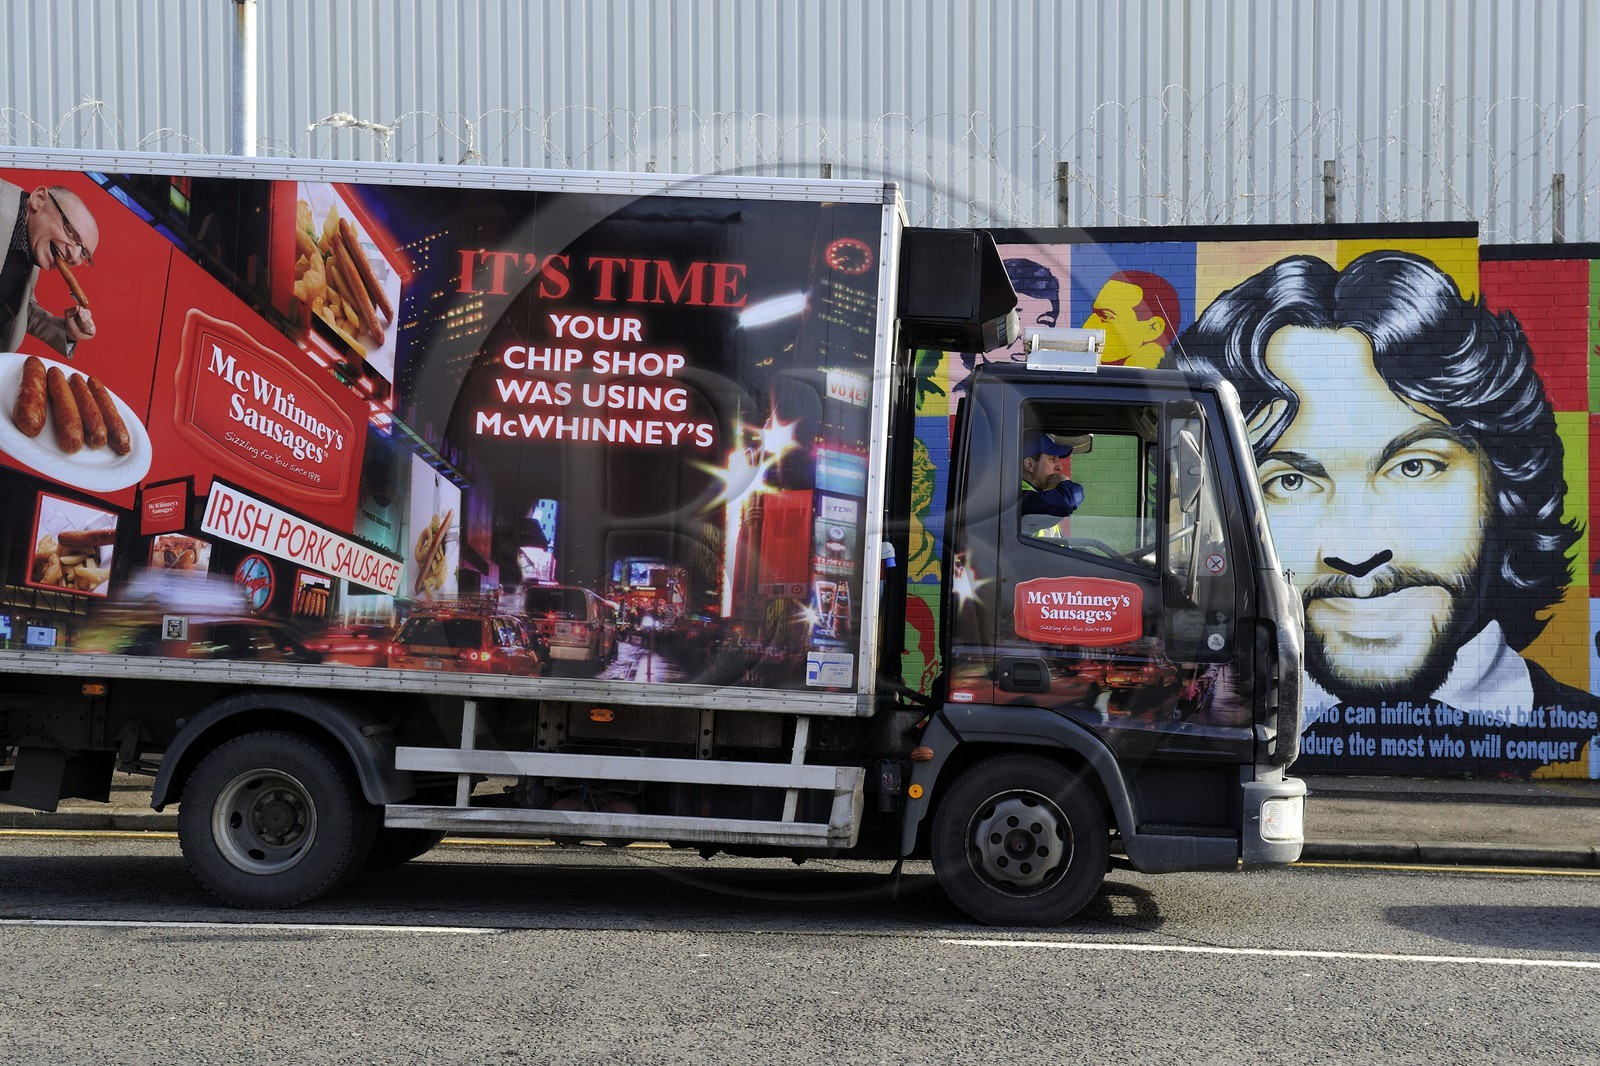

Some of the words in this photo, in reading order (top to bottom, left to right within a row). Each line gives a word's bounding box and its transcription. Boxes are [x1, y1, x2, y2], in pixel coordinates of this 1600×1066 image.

[455, 249, 570, 299] IT'S
[588, 256, 748, 309] TIME
[549, 313, 643, 342] YOUR
[503, 345, 583, 373] CHIP
[592, 349, 685, 378] SHOP
[207, 343, 344, 451] McWhinney's
[495, 378, 572, 406] WAS
[582, 383, 688, 412] USING
[475, 411, 714, 448] McWHINNEY'S
[224, 431, 259, 458] Sizzling
[260, 449, 273, 461] for
[275, 453, 289, 468] You
[832, 505, 854, 514] TDK
[207, 490, 273, 547] IRISH
[273, 518, 332, 567] PORK
[331, 542, 400, 591] SAUSAGE
[1027, 591, 1131, 610] McWhinney's
[1303, 701, 1340, 724] who
[1344, 705, 1376, 724] can
[1381, 701, 1432, 727] inflict
[1434, 702, 1464, 726] the
[1468, 705, 1512, 728] most
[1516, 705, 1546, 729] but
[1549, 704, 1598, 729] those
[1348, 732, 1376, 757] the
[1381, 734, 1425, 757] most
[1429, 733, 1465, 758] who
[1470, 734, 1501, 758] will
[1506, 740, 1578, 764] conquer
